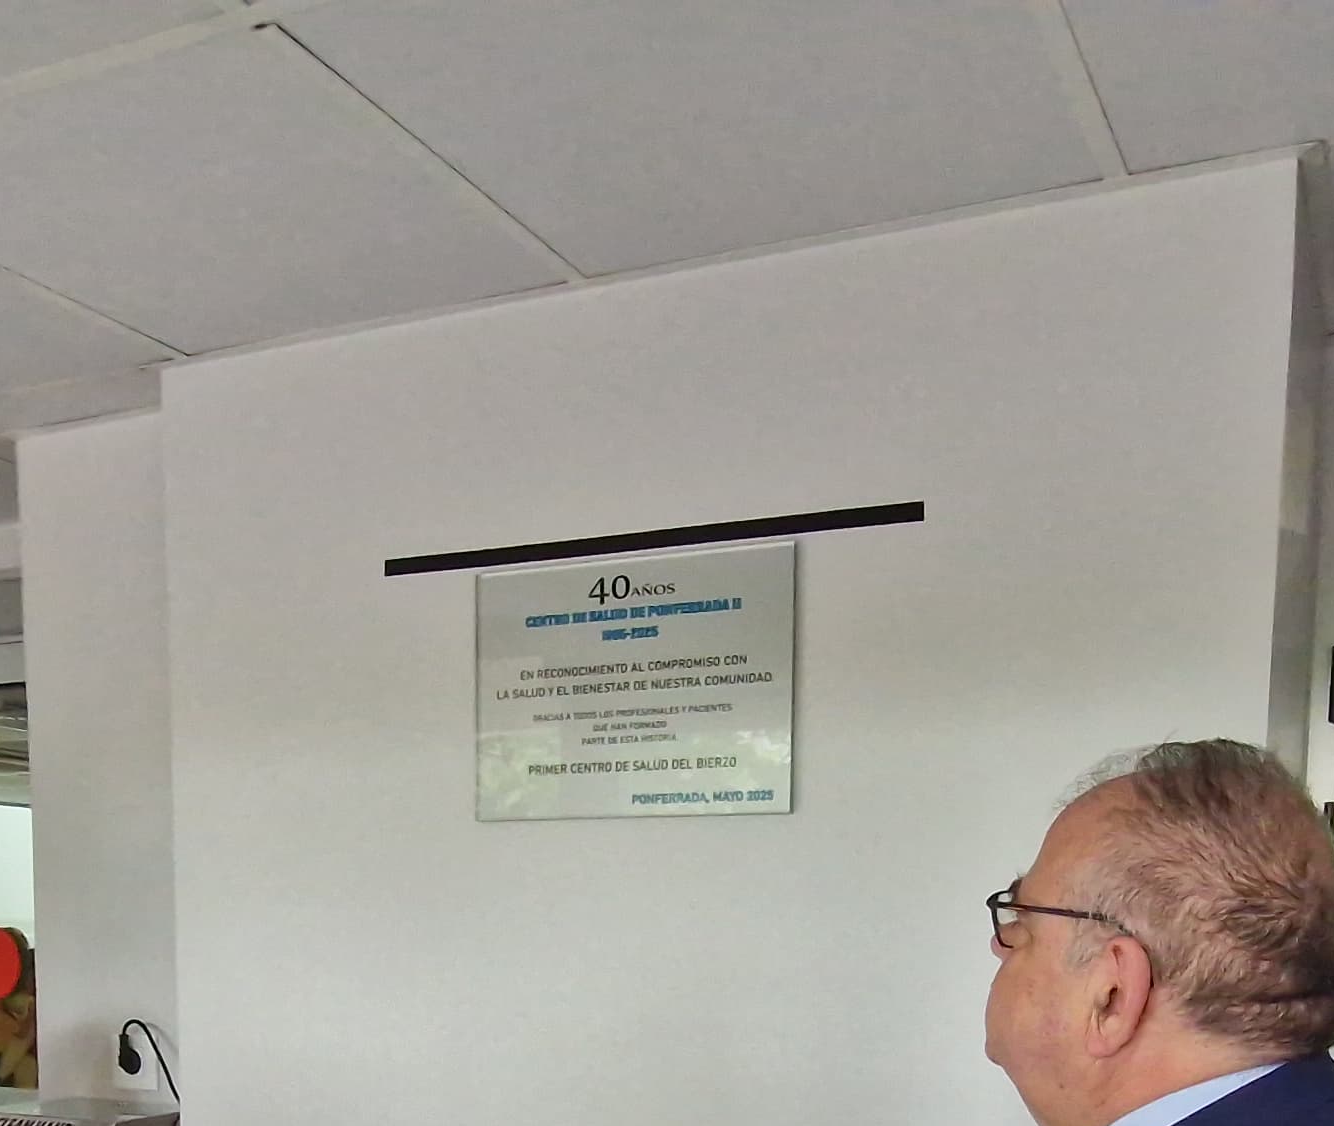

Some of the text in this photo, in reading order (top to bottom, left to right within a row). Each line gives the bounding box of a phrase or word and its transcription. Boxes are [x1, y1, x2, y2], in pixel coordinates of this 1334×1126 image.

[526, 613, 569, 627] CENTRO
[588, 608, 627, 622] SALUD
[630, 606, 646, 618] DE
[648, 599, 730, 617] PONFERRADA
[520, 655, 748, 680] EN RECONOCIMIENTO AL COMPROMISO CON
[496, 690, 510, 700] LA
[512, 687, 546, 699] SALUD
[548, 687, 554, 696] Y
[556, 686, 569, 696] EL
[572, 681, 630, 695] BIENESTAR
[633, 680, 647, 691] DE
[651, 677, 702, 690] NUESTRA
[688, 703, 733, 713] PACIENTES
[528, 757, 736, 775] PRIMER CENTRO DE SALUD DEL BIERZO
[712, 791, 744, 802] MAYO
